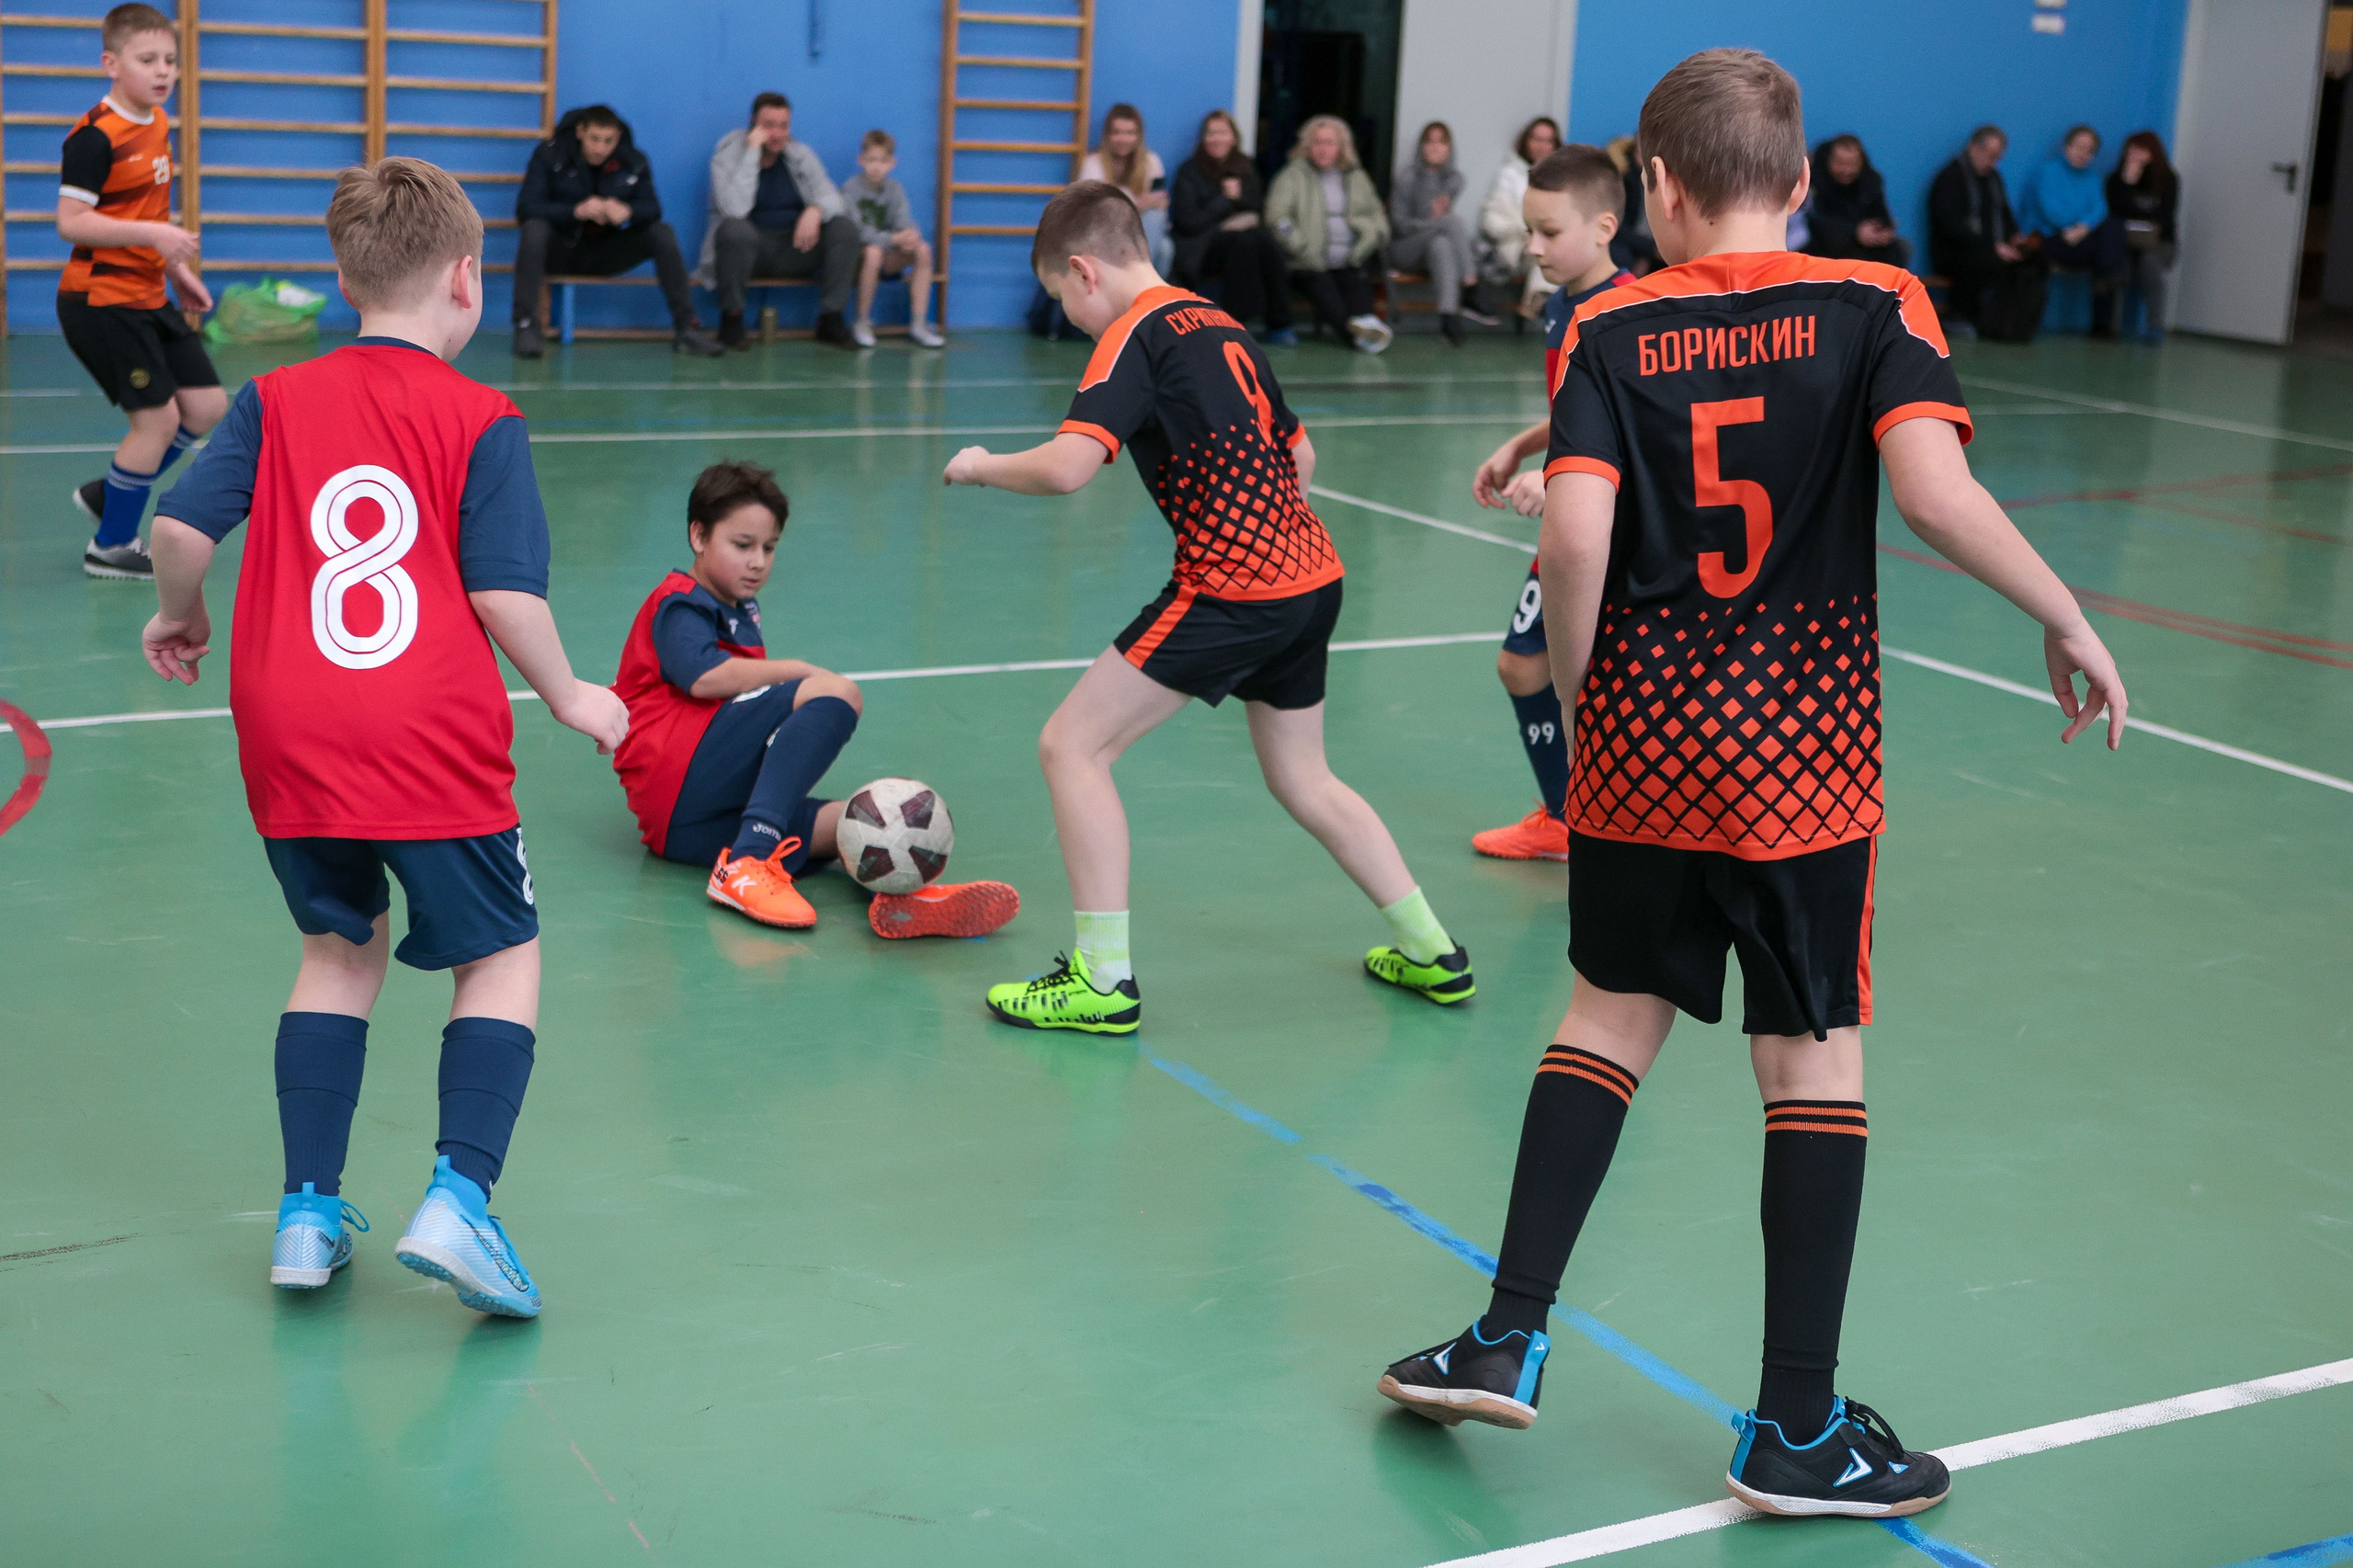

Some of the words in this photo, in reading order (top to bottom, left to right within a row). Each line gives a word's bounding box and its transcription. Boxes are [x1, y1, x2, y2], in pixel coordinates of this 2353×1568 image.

[1222, 341, 1272, 447] 9
[1638, 315, 1816, 376] БОРИСКИН
[1690, 396, 1773, 598] 5
[310, 464, 419, 670] 8
[1528, 722, 1555, 745] 99
